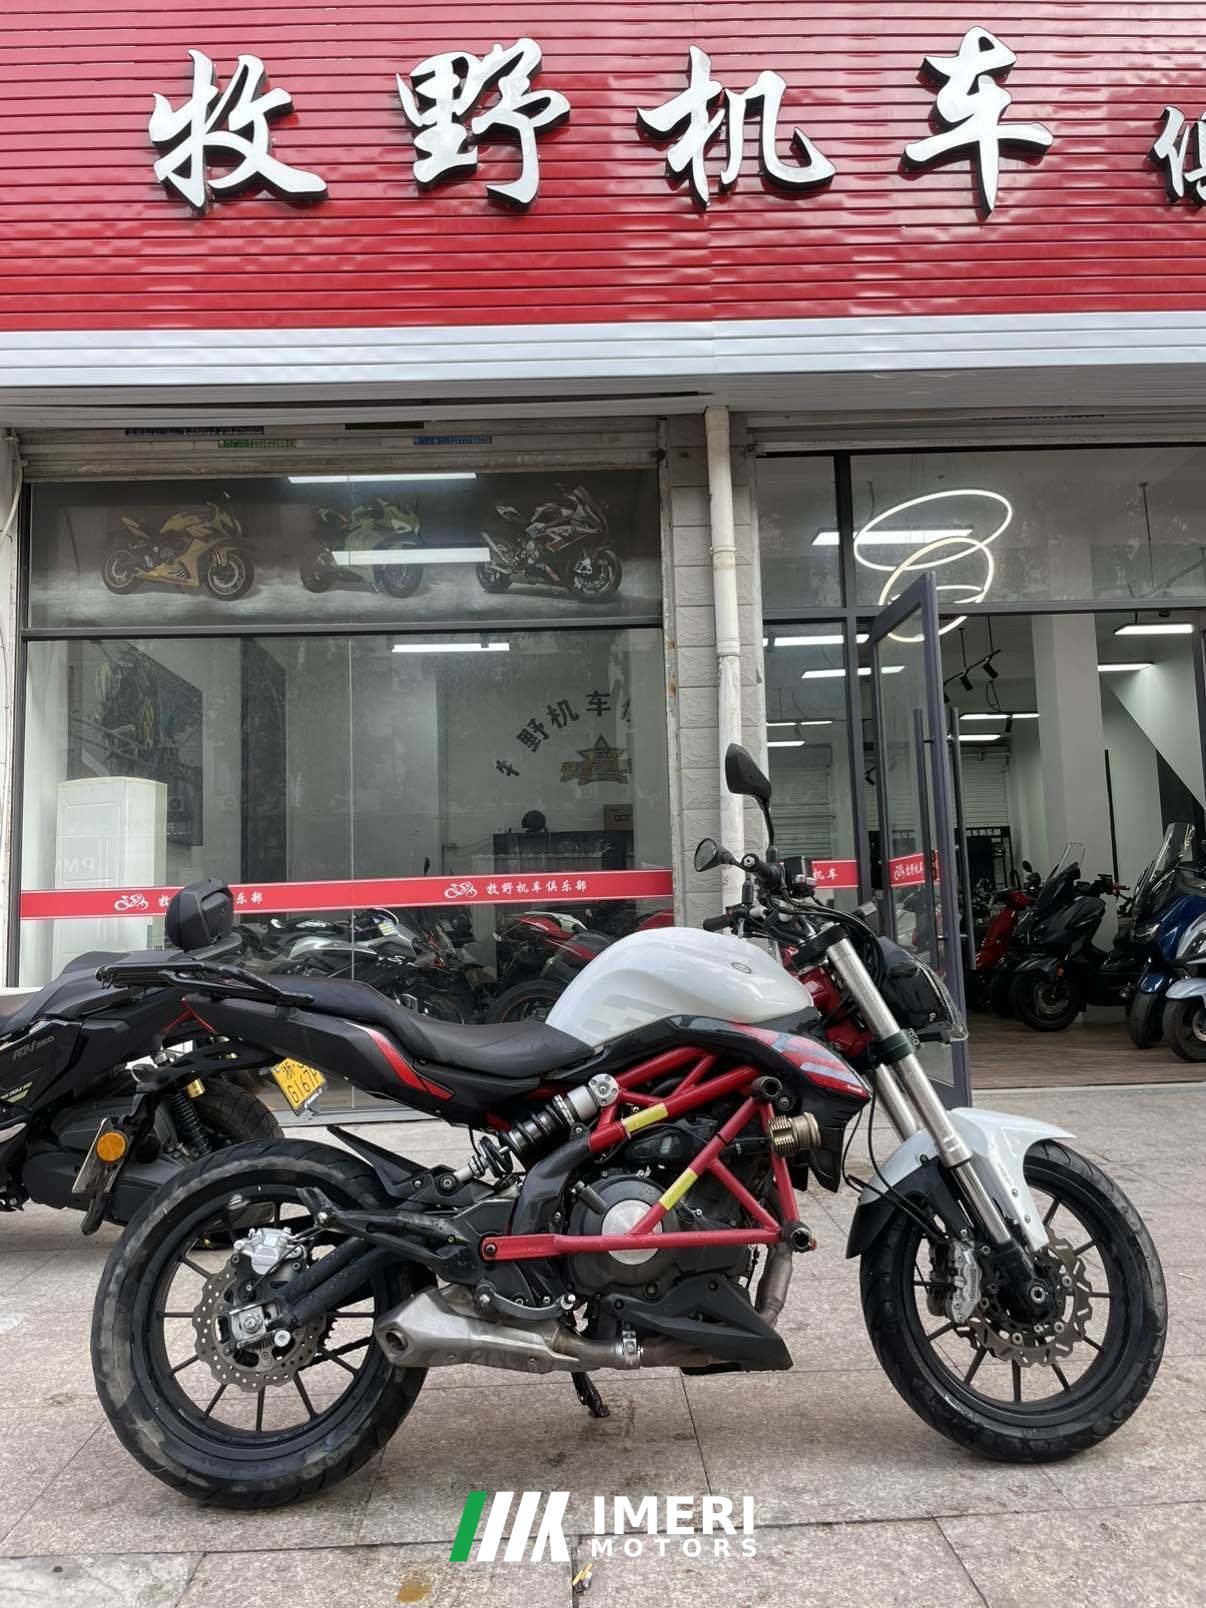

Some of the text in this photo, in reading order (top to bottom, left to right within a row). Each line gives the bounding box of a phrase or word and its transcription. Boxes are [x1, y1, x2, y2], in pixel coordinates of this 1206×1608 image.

[486, 879, 587, 895] 牧野机车俱乐部
